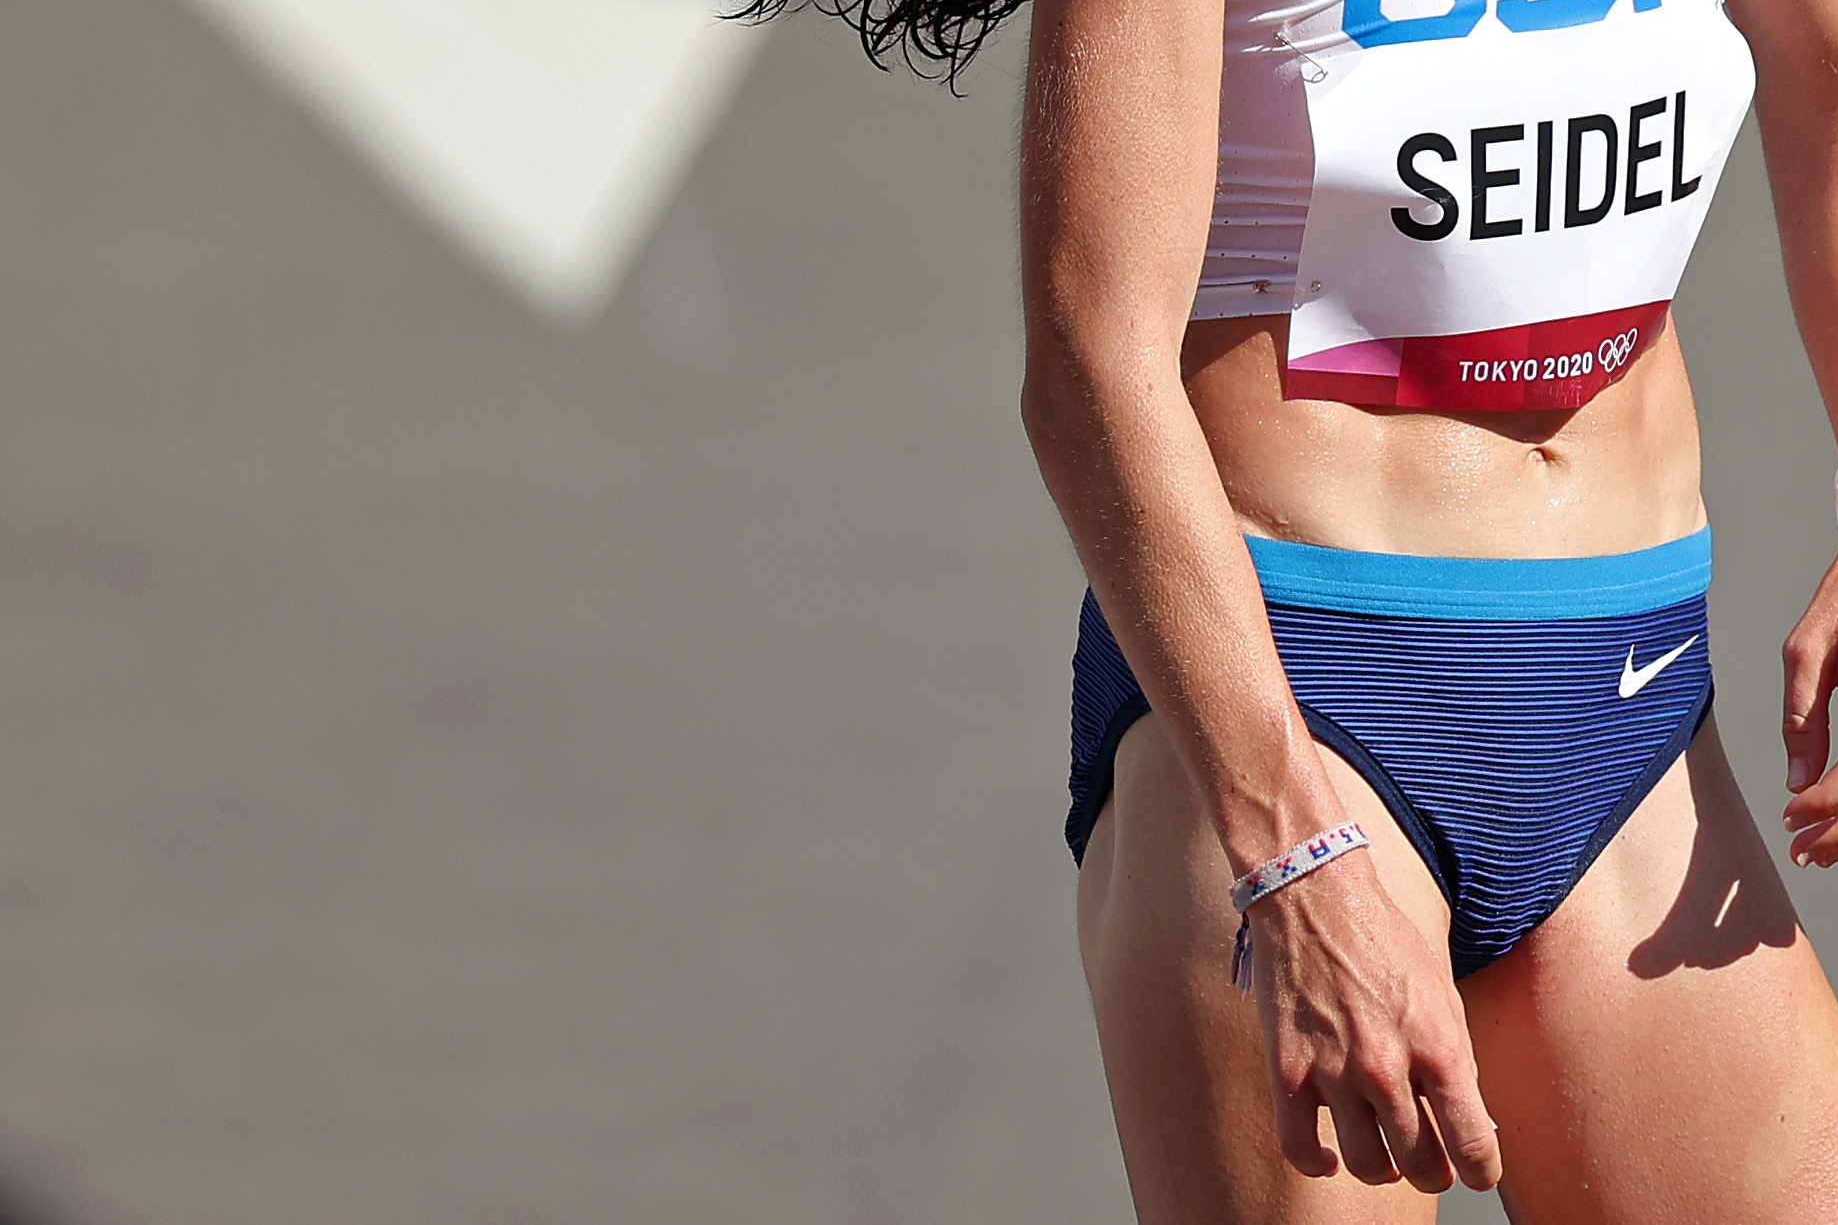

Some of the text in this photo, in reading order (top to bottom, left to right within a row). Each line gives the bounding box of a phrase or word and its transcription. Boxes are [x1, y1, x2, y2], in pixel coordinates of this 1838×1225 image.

[1390, 90, 1703, 241] SEIDEL
[1459, 351, 1594, 382] TOKYO 2020
